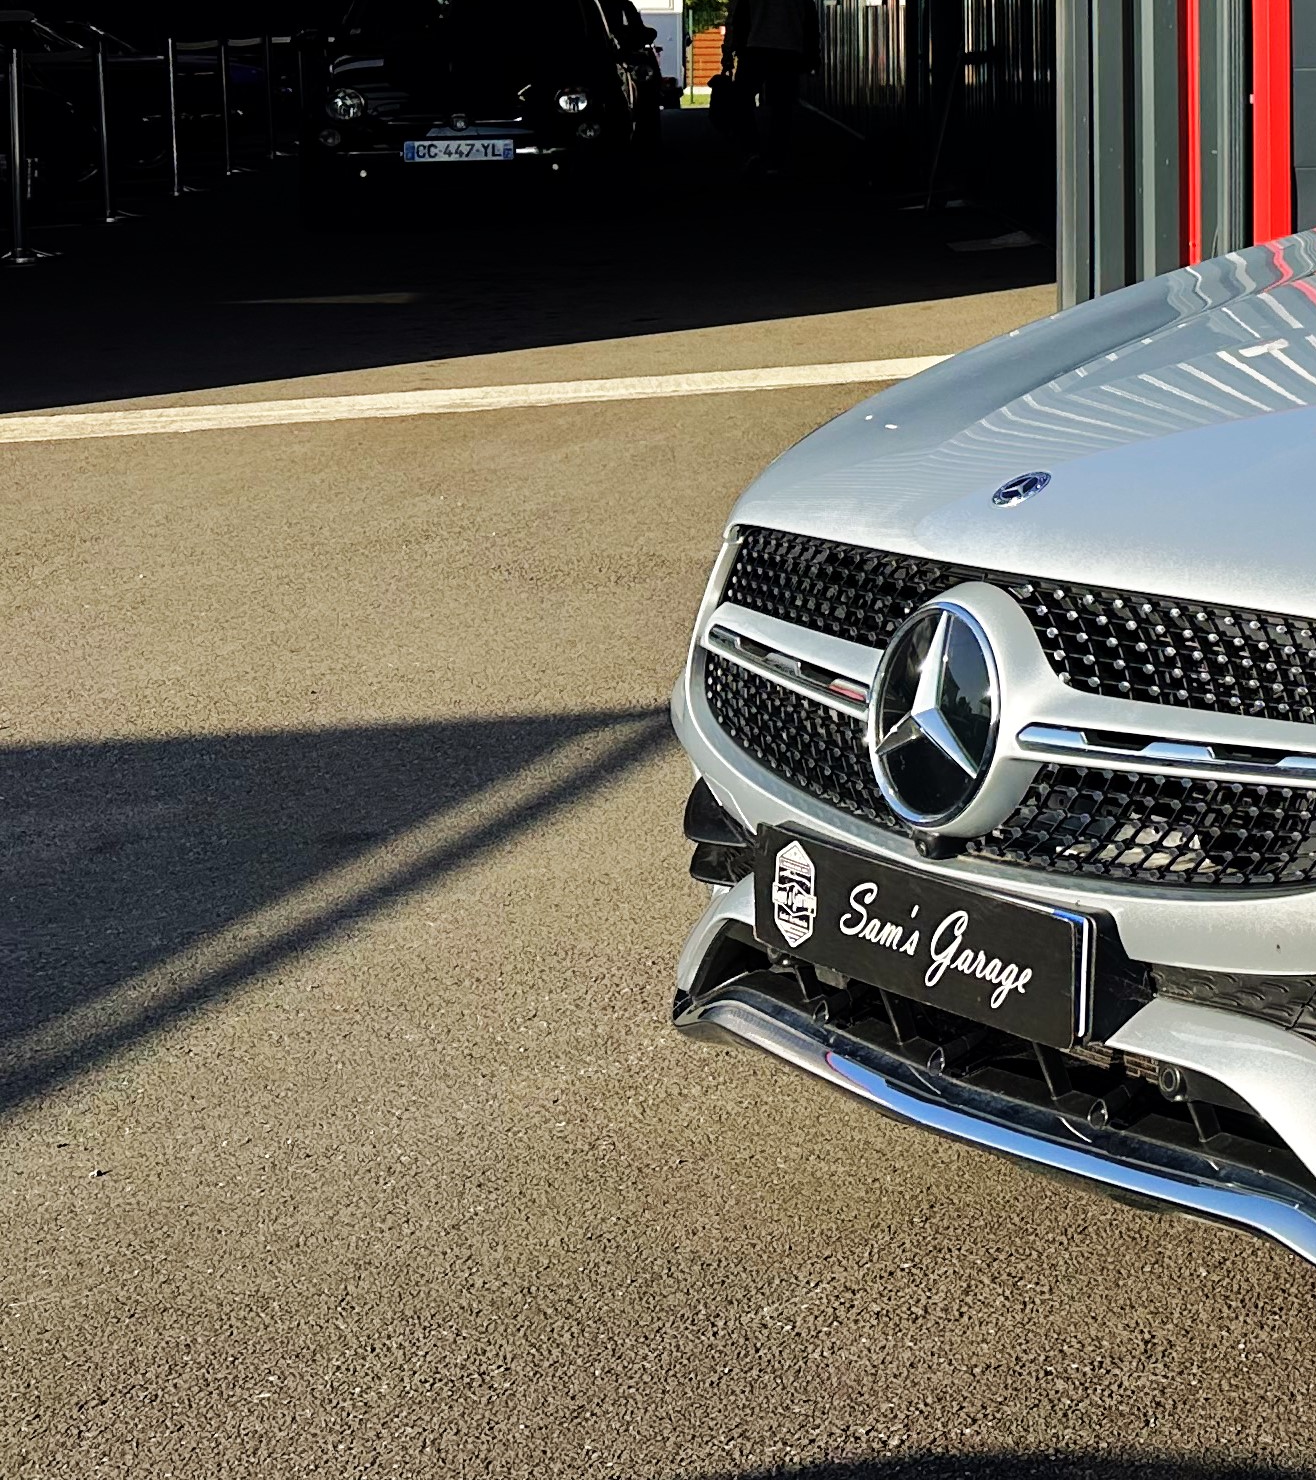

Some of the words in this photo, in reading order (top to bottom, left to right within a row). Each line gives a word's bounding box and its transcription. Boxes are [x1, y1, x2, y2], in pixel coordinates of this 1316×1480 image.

[416, 143, 502, 159] CC-447-YL
[839, 881, 921, 956] Sam's
[925, 910, 1033, 1009] Garage
